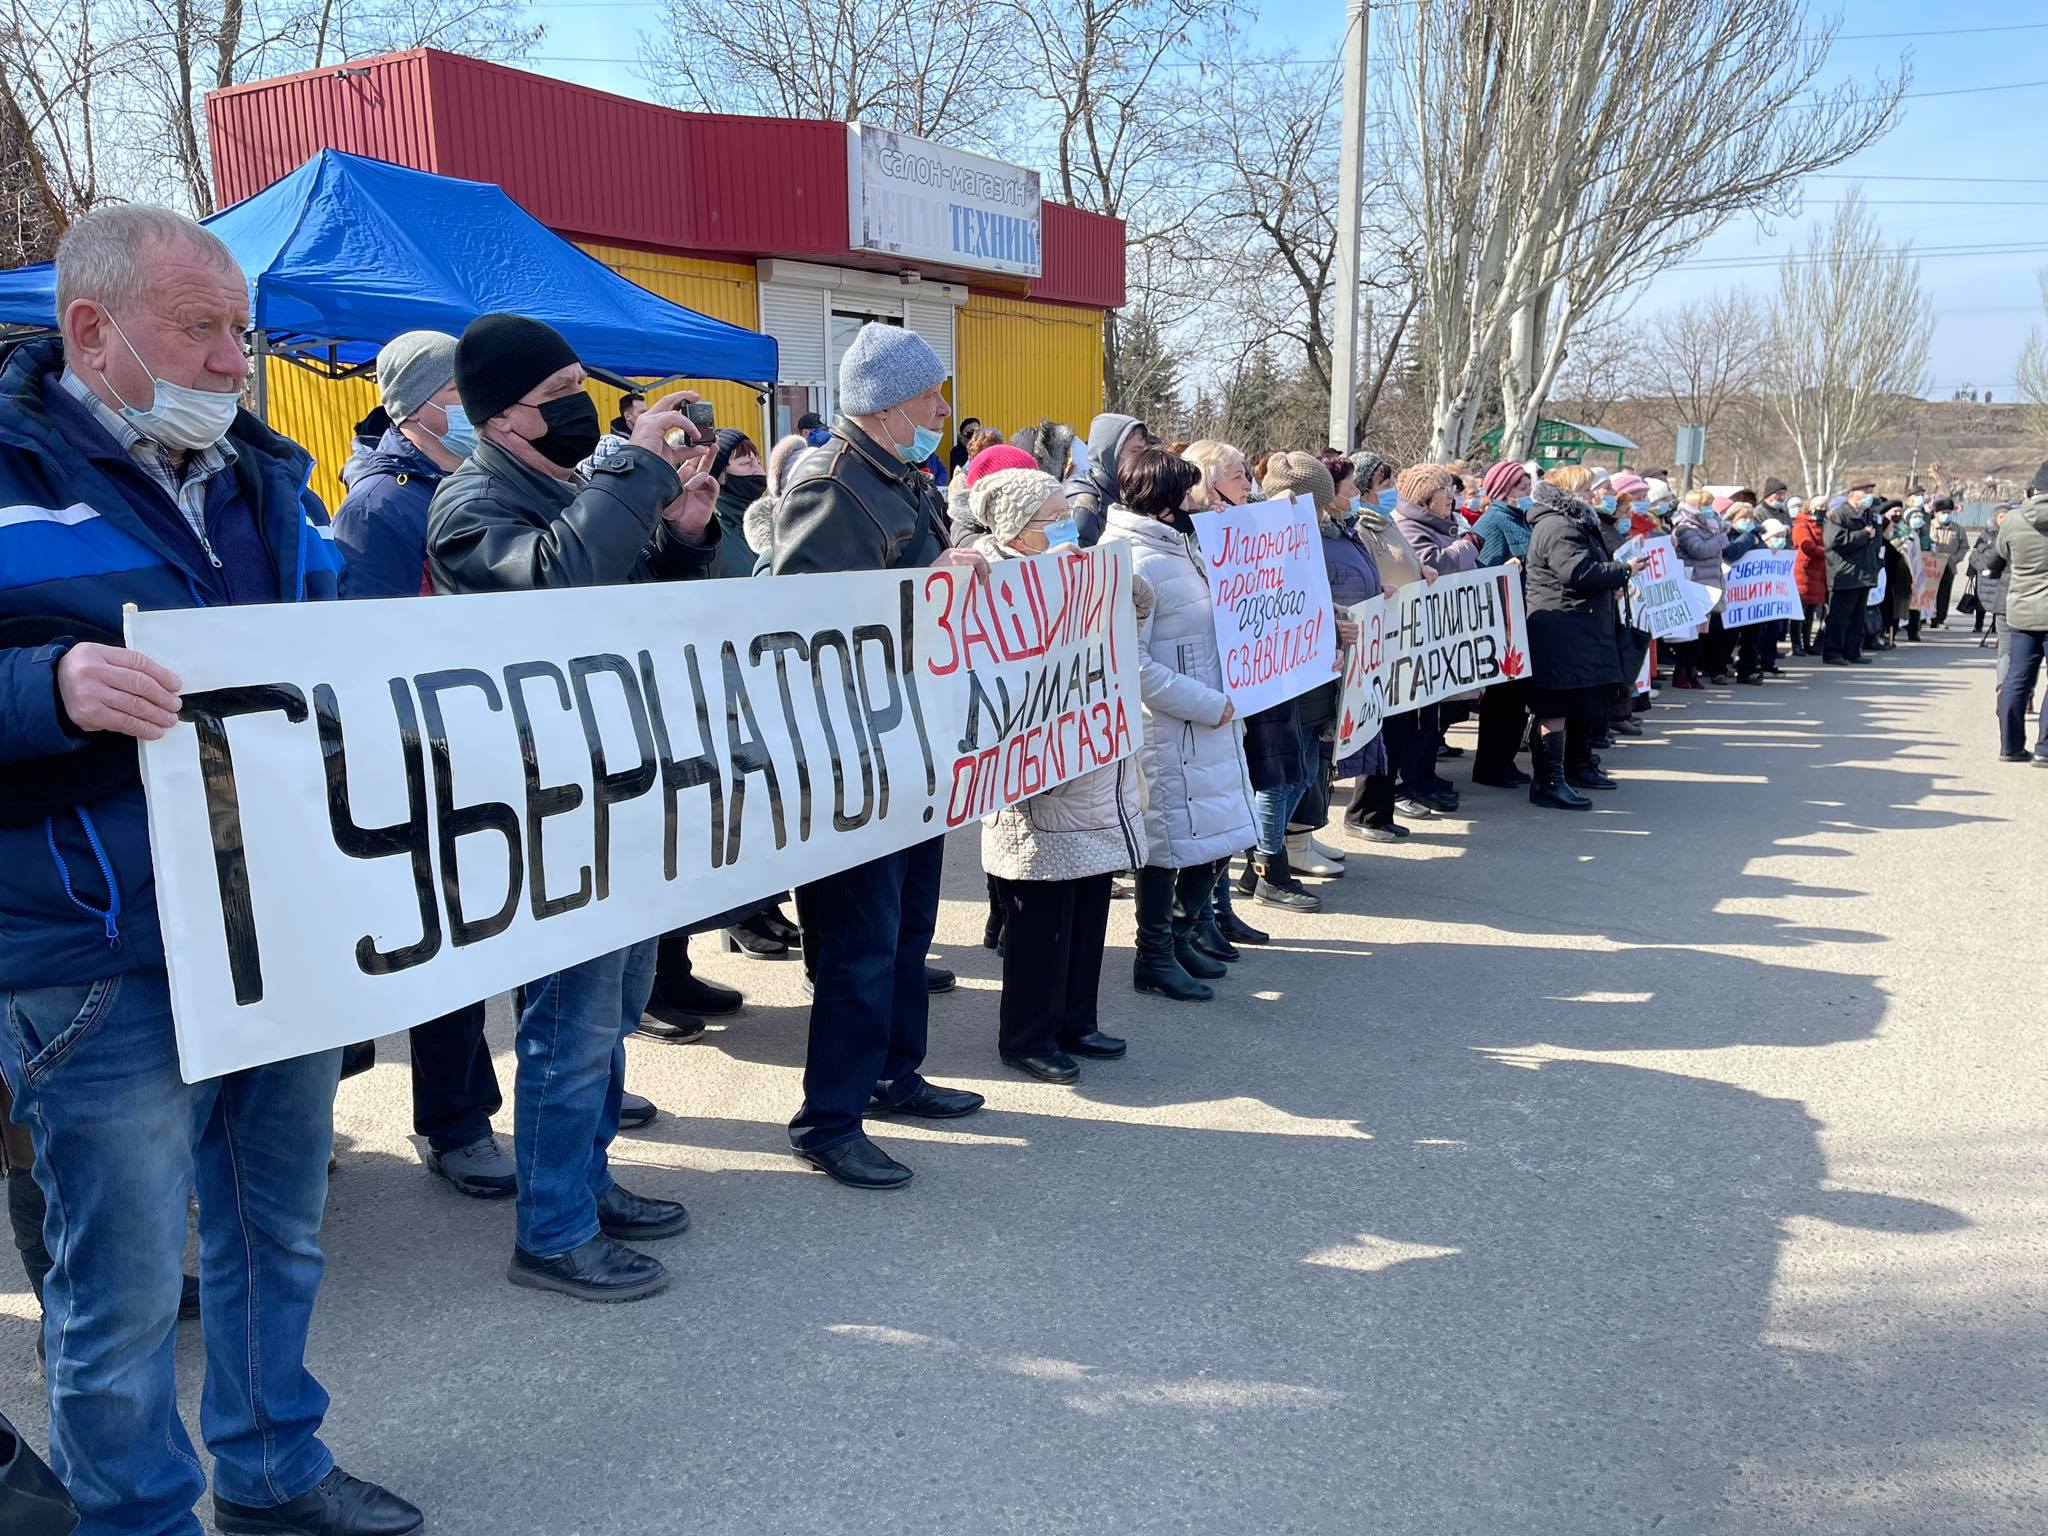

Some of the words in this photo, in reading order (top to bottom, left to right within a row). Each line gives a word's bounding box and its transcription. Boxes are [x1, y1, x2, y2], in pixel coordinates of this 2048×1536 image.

[1216, 566, 1284, 612] проти
[1236, 586, 1305, 639] газового
[1728, 607, 1743, 624] ОТ
[946, 746, 1001, 828] ОТ
[1003, 696, 1131, 804] ОБЛГАЗА
[178, 580, 936, 1006] ГУБЕРНАТОР!
